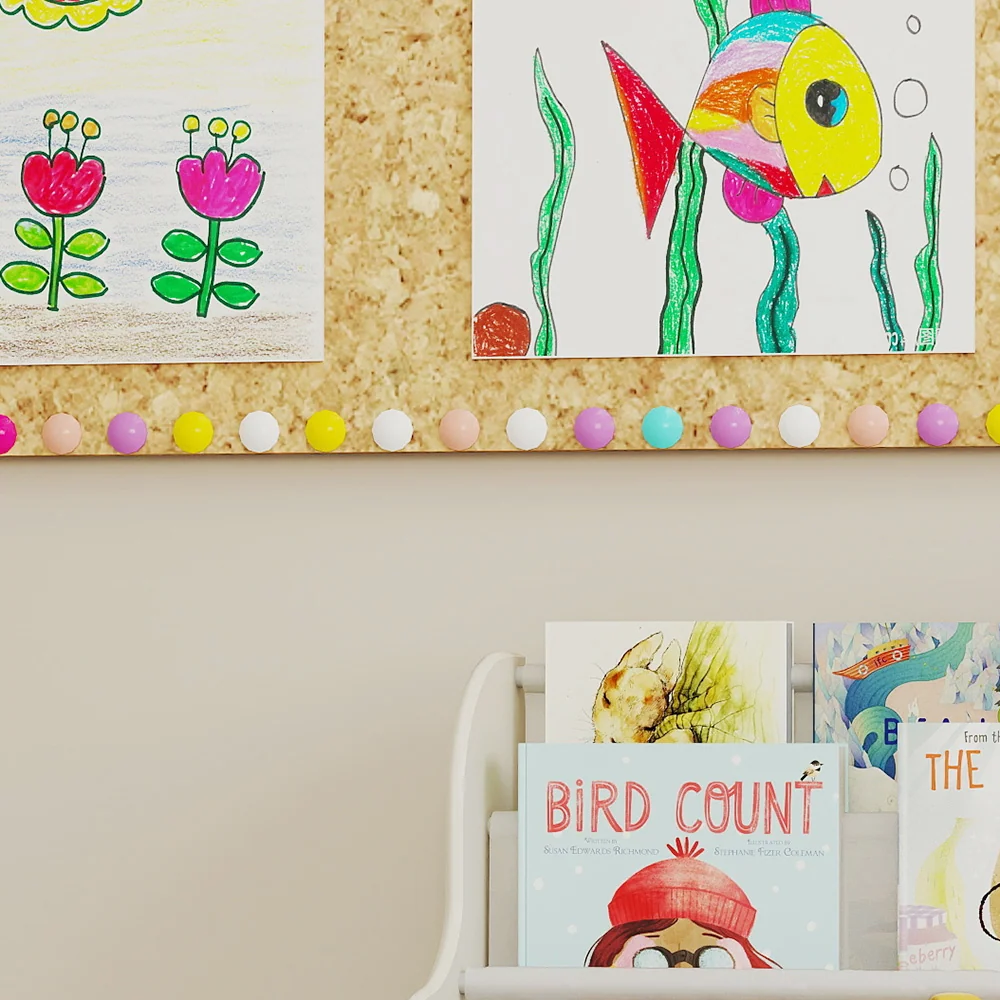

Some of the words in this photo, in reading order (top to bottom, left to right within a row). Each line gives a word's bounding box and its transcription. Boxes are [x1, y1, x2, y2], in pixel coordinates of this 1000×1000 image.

[964, 731, 988, 743] From
[926, 749, 984, 791] THE
[676, 781, 823, 834] COUNT
[570, 845, 611, 855] EDWARDS
[613, 846, 660, 855] RICHMOND
